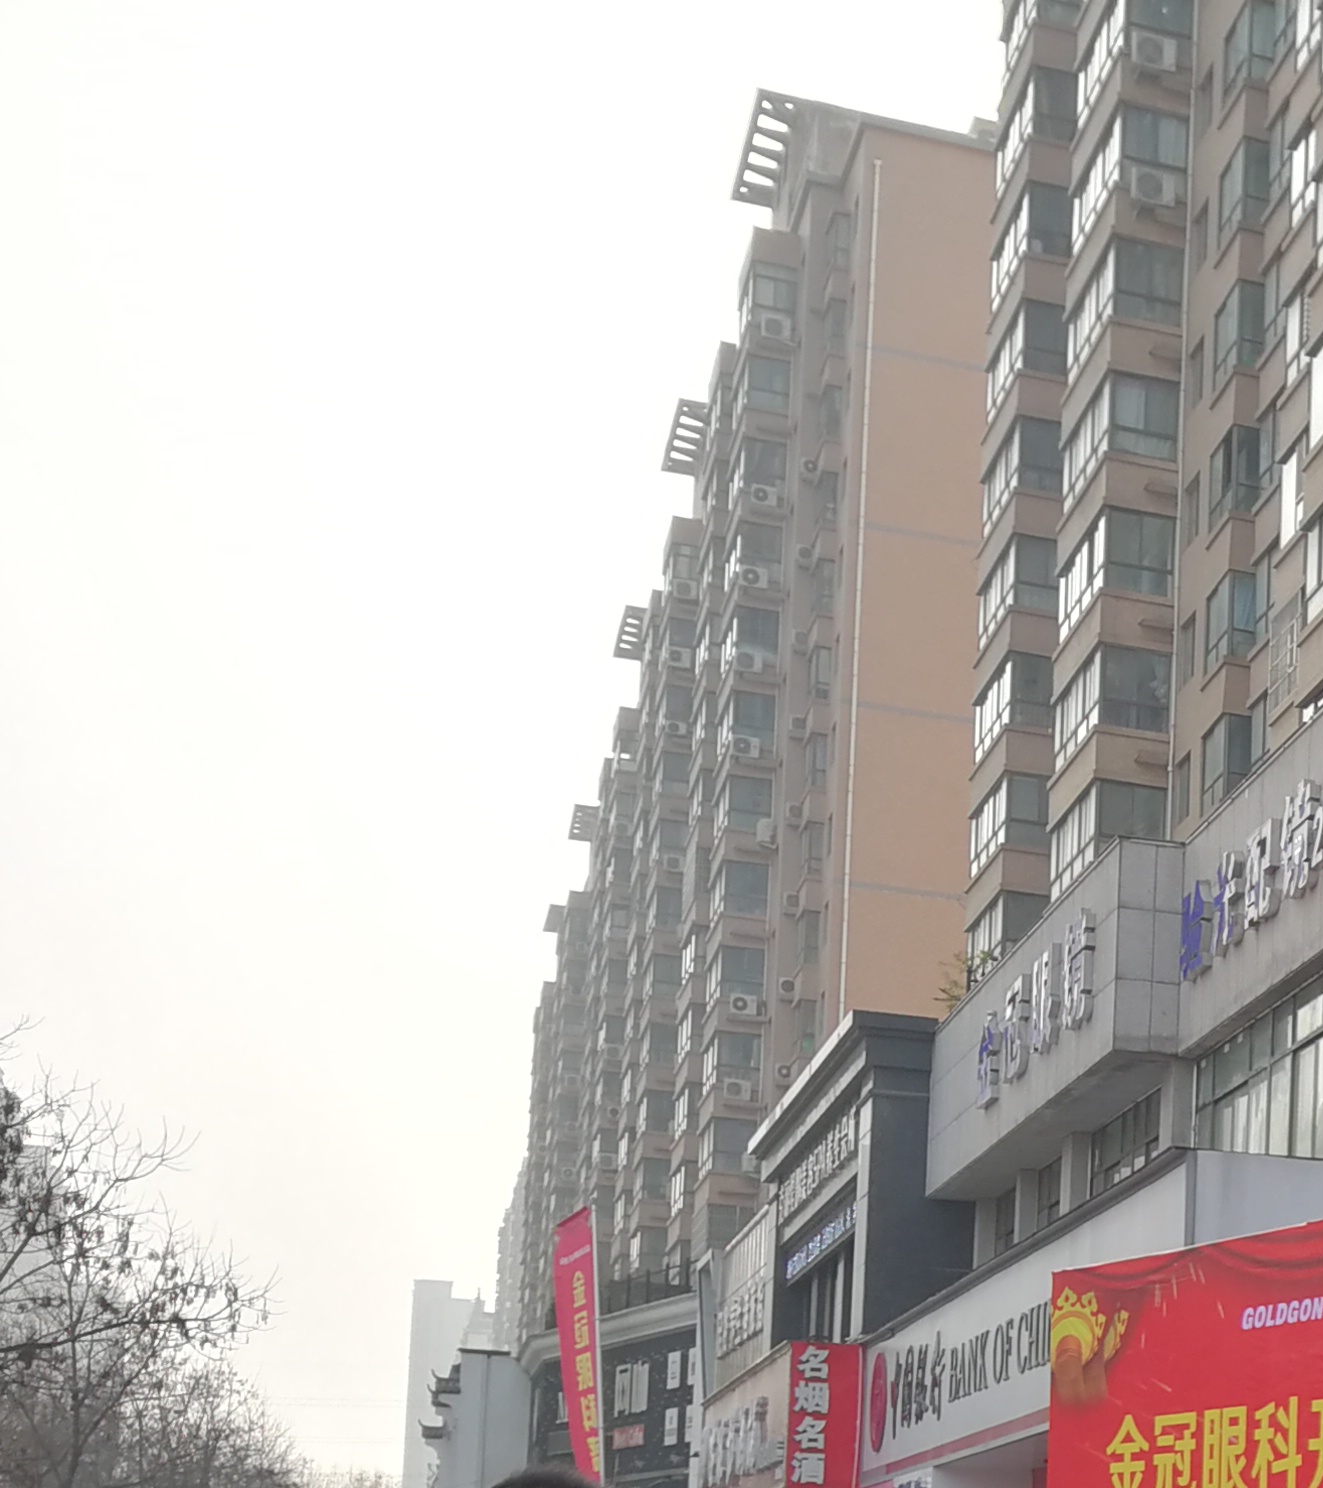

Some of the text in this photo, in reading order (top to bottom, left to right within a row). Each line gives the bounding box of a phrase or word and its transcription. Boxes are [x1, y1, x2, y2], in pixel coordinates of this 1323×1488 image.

[790, 1345, 830, 1486] 名烟名酒
[948, 1328, 991, 1404] BANK
[993, 1318, 1014, 1385] OF
